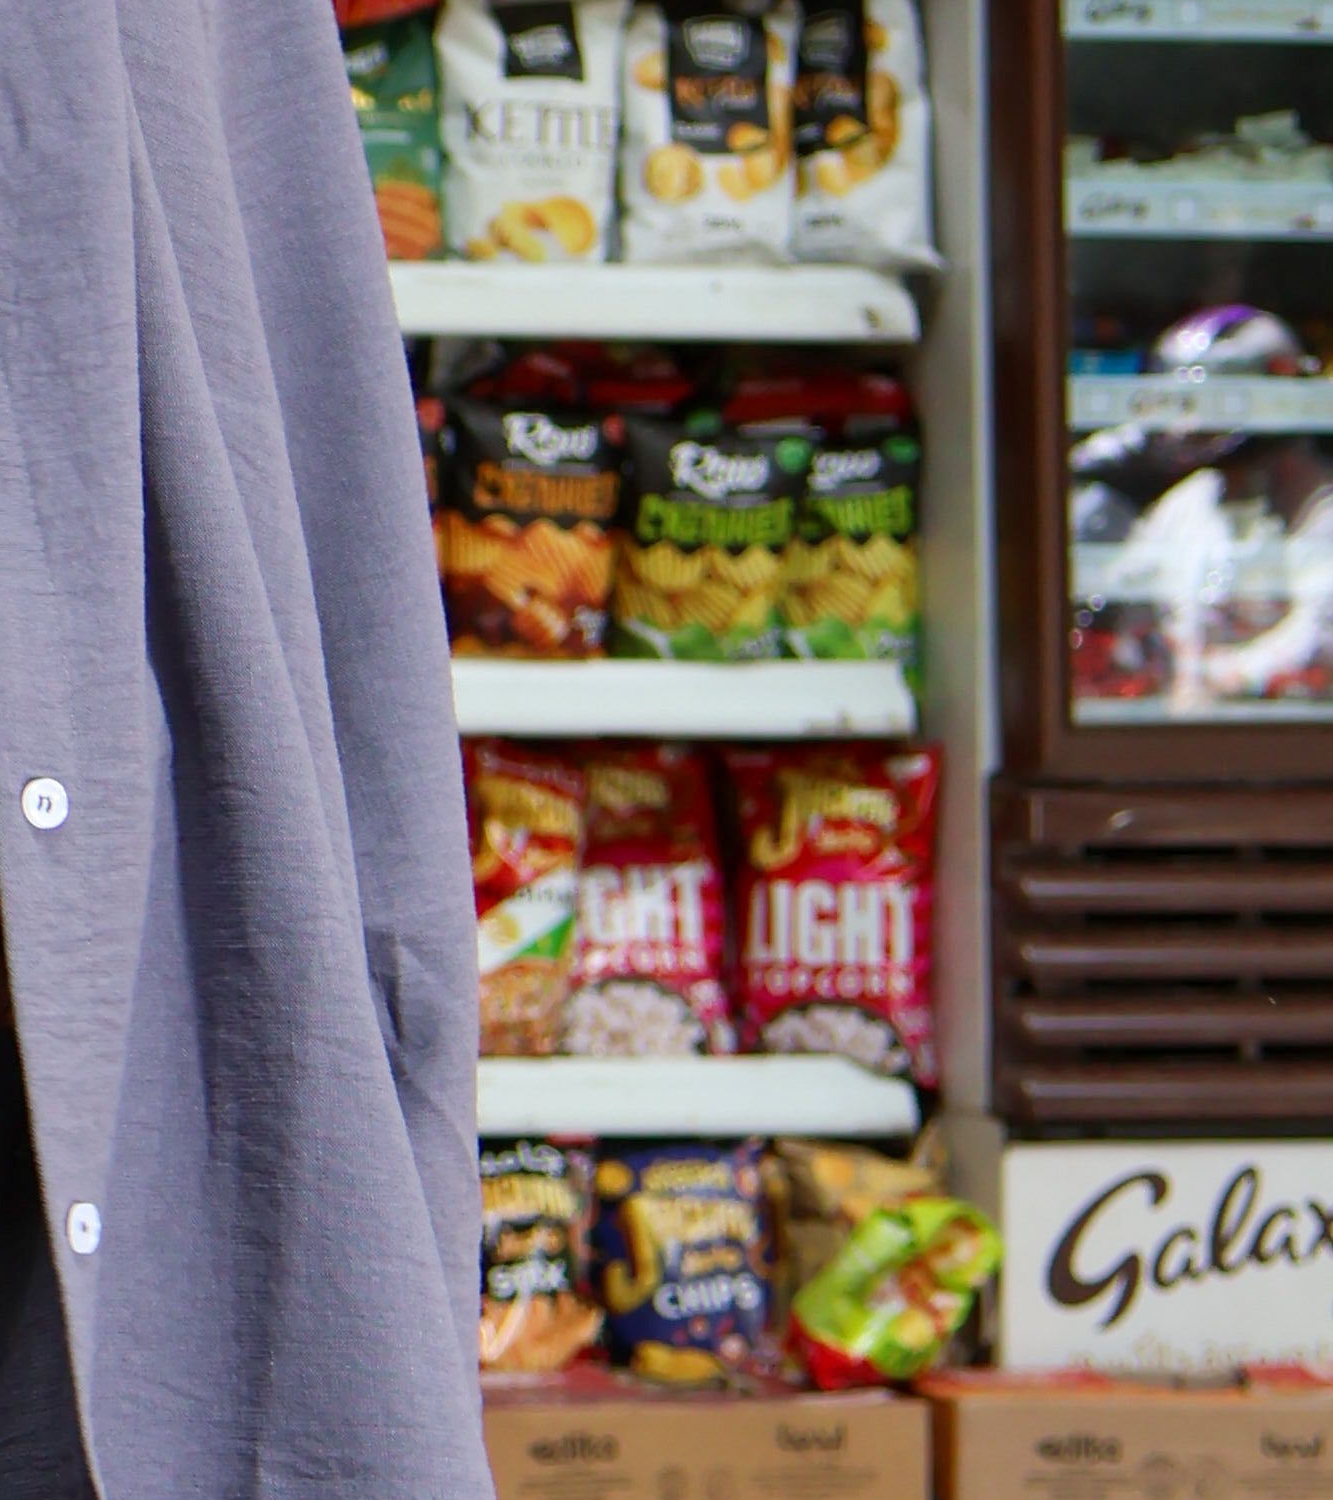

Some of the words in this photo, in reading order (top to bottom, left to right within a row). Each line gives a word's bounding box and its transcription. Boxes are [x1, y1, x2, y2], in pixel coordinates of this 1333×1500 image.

[580, 861, 717, 943] GHT
[747, 877, 916, 967] LIGHT
[652, 1273, 763, 1320] CHIPS
